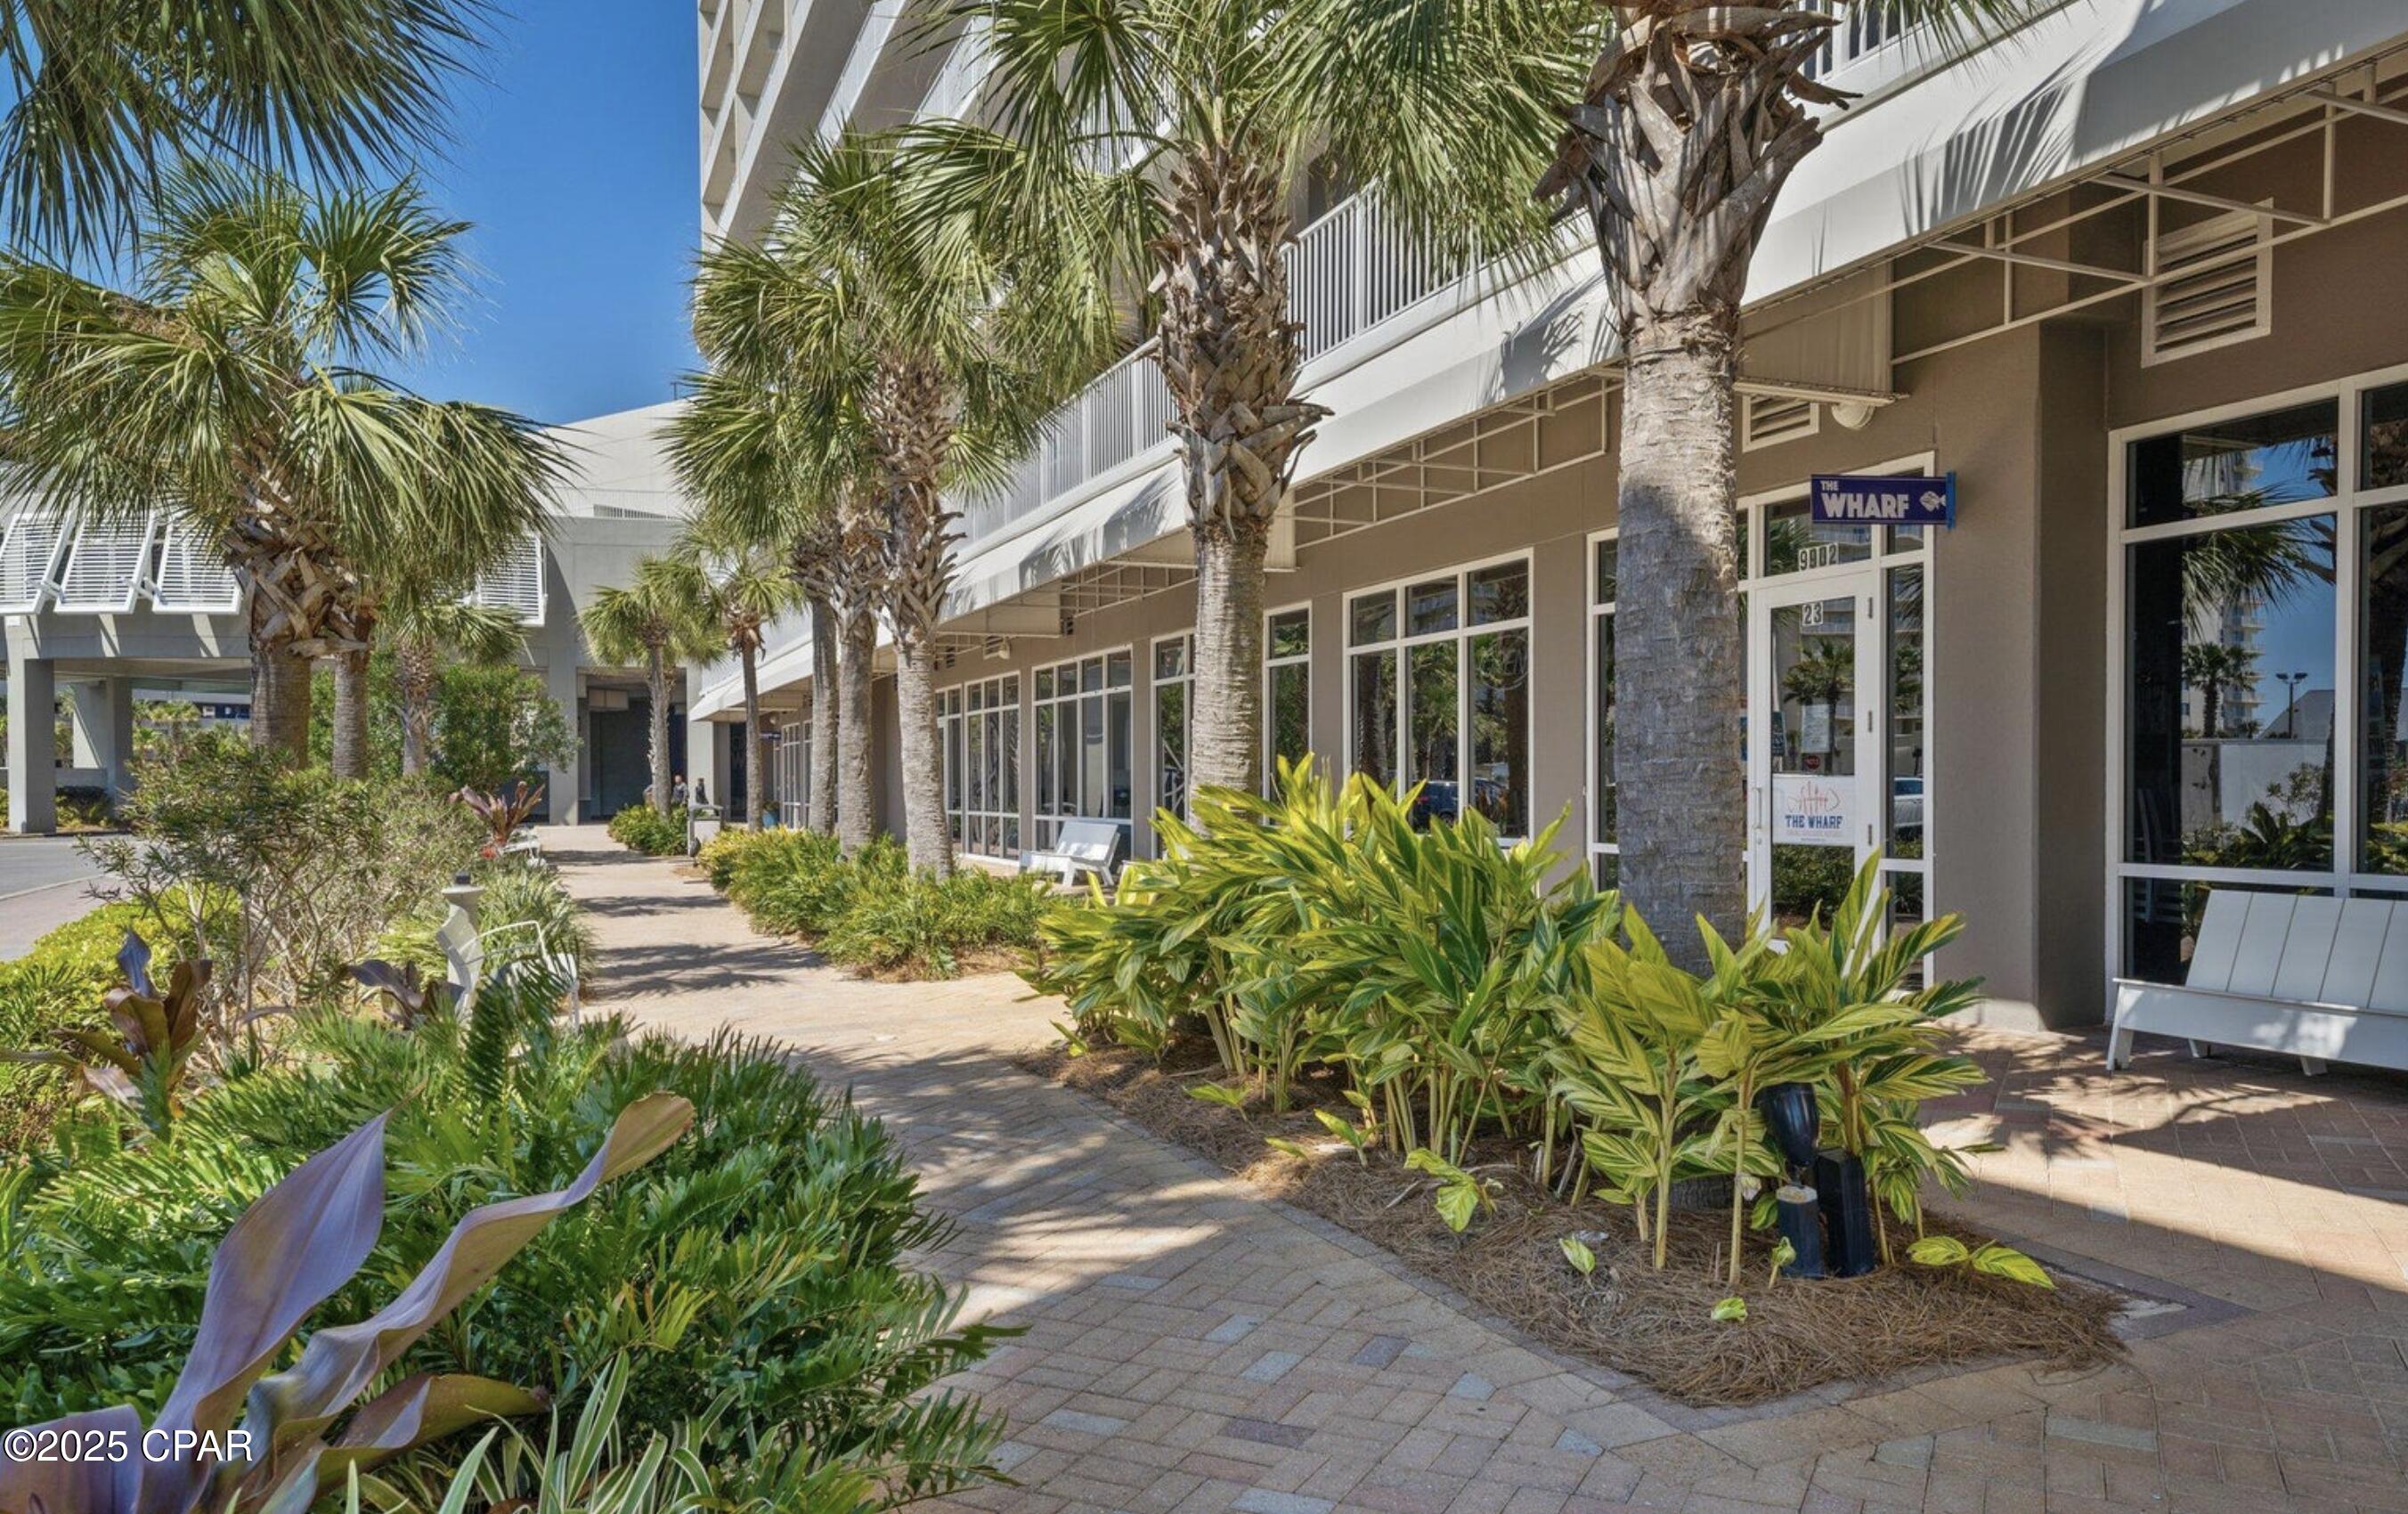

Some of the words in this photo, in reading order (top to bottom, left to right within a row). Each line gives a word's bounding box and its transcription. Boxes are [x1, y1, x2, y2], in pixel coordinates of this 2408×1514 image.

[1820, 480, 1839, 492] THE
[1821, 492, 1909, 518] WHARF
[1804, 602, 1822, 624] 23
[1785, 815, 1805, 828] THE
[1807, 815, 1843, 829] WHARF
